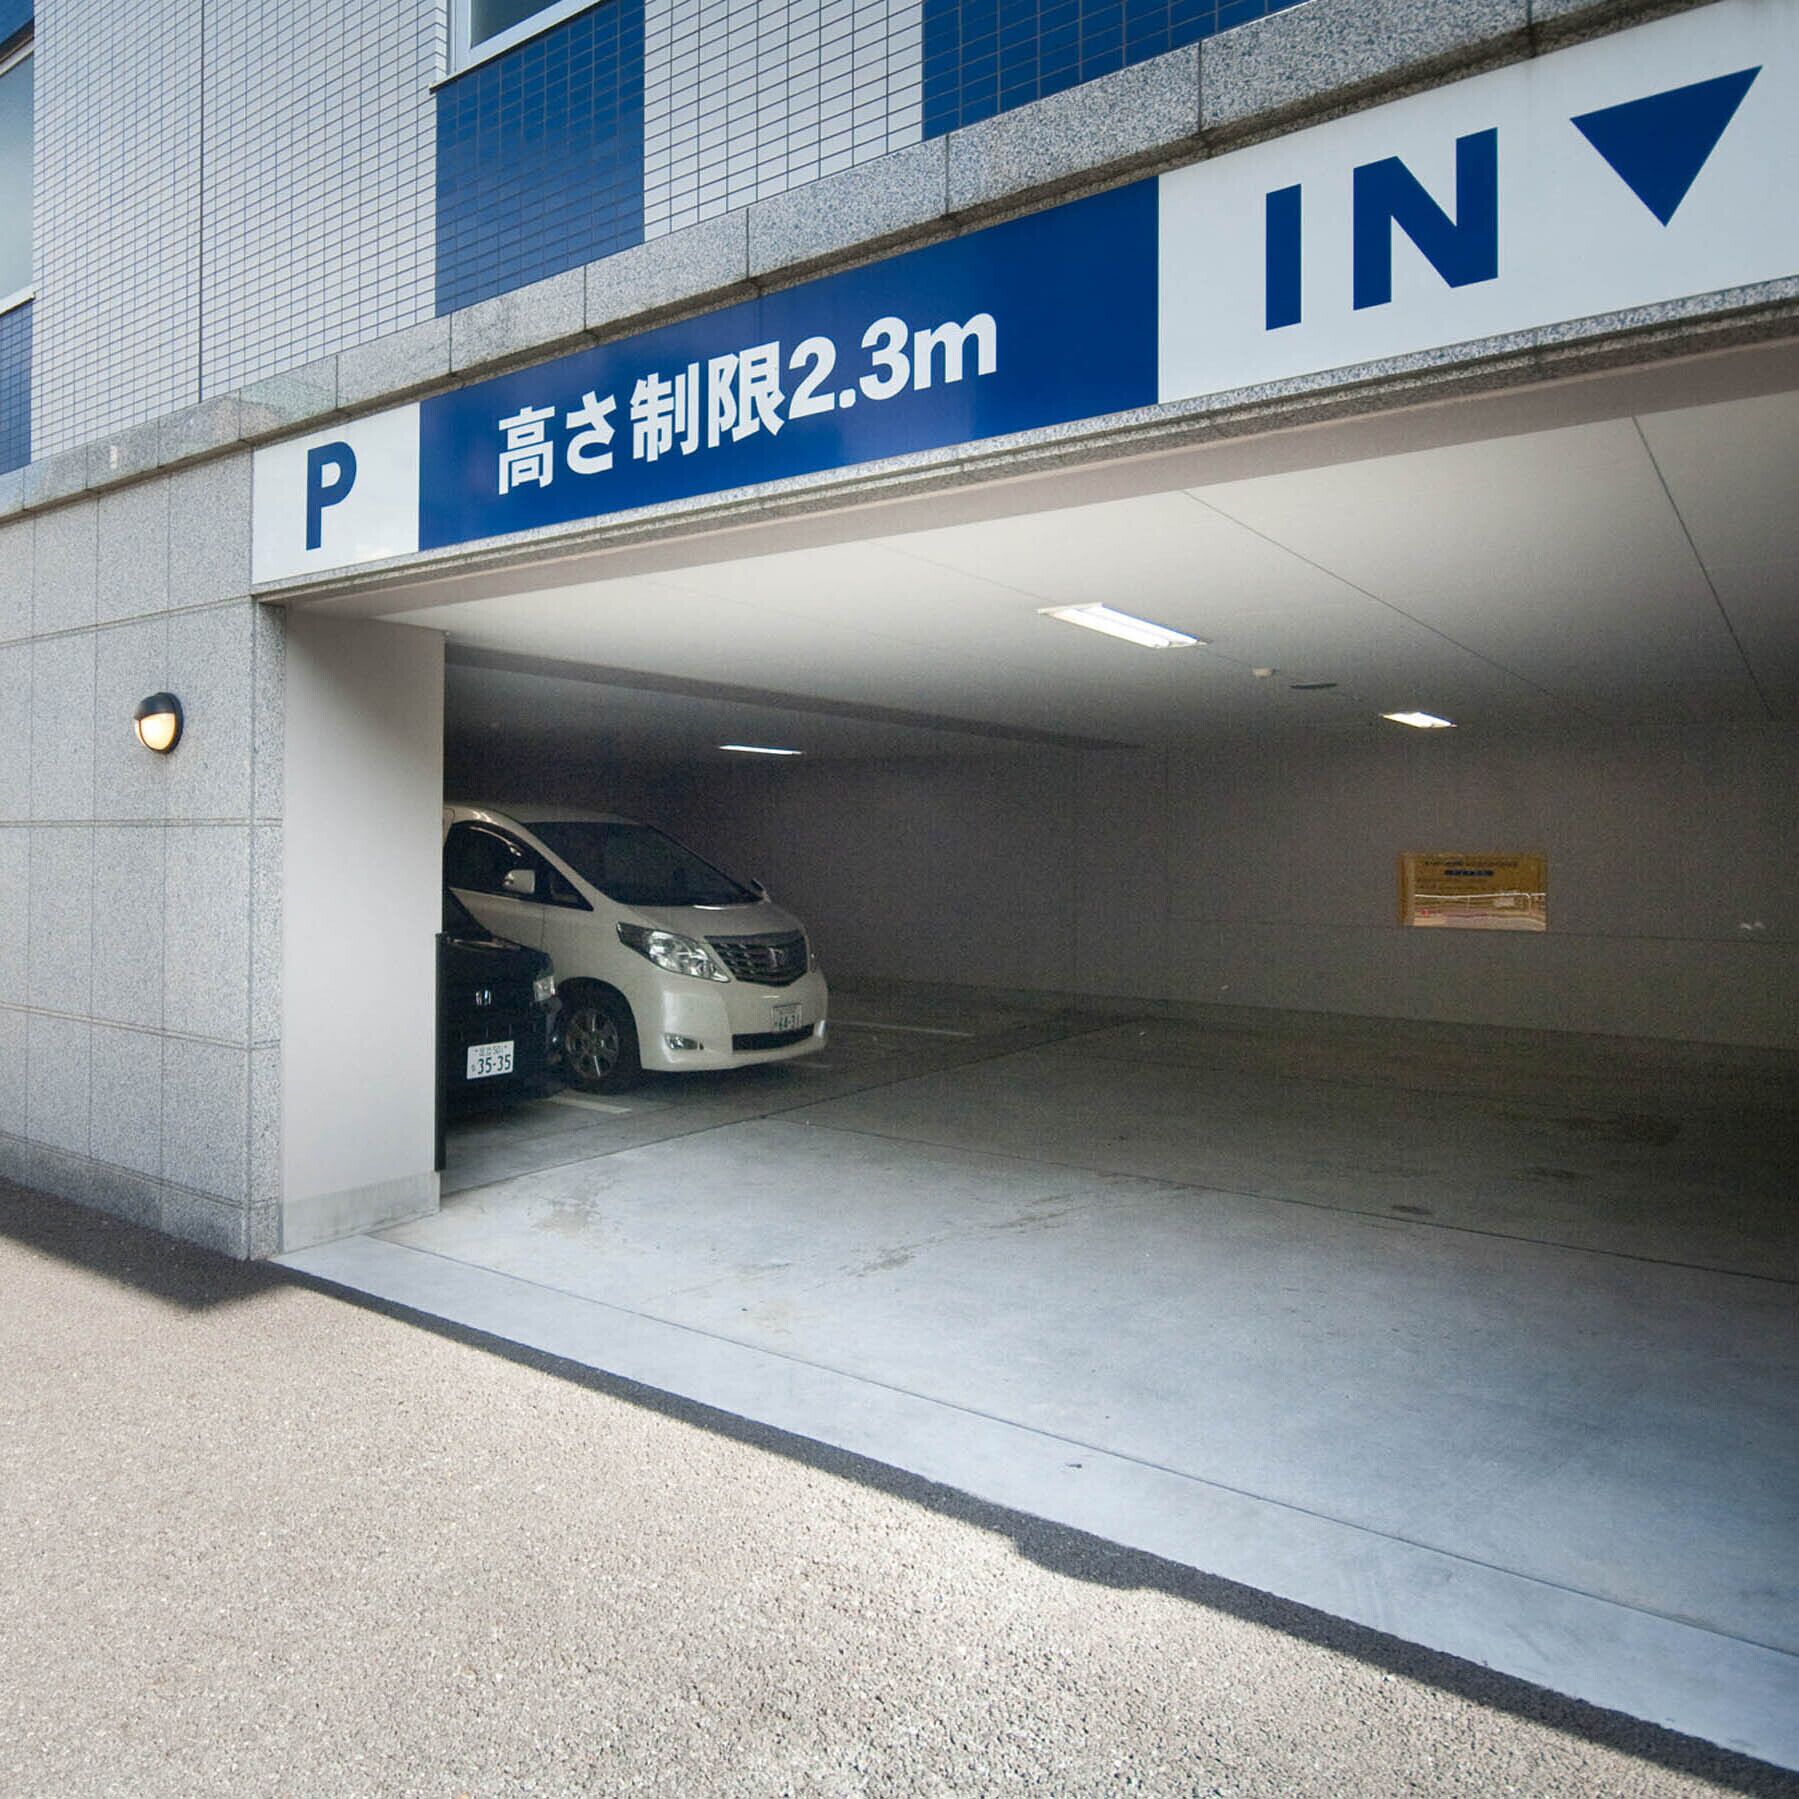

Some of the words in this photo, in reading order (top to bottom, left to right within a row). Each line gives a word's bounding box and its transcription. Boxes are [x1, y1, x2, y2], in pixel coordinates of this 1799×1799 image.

[1266, 127, 1498, 331] IN
[497, 313, 997, 495] 高さ制限2.3m
[306, 441, 357, 551] P
[478, 1054, 511, 1075] 35-35
